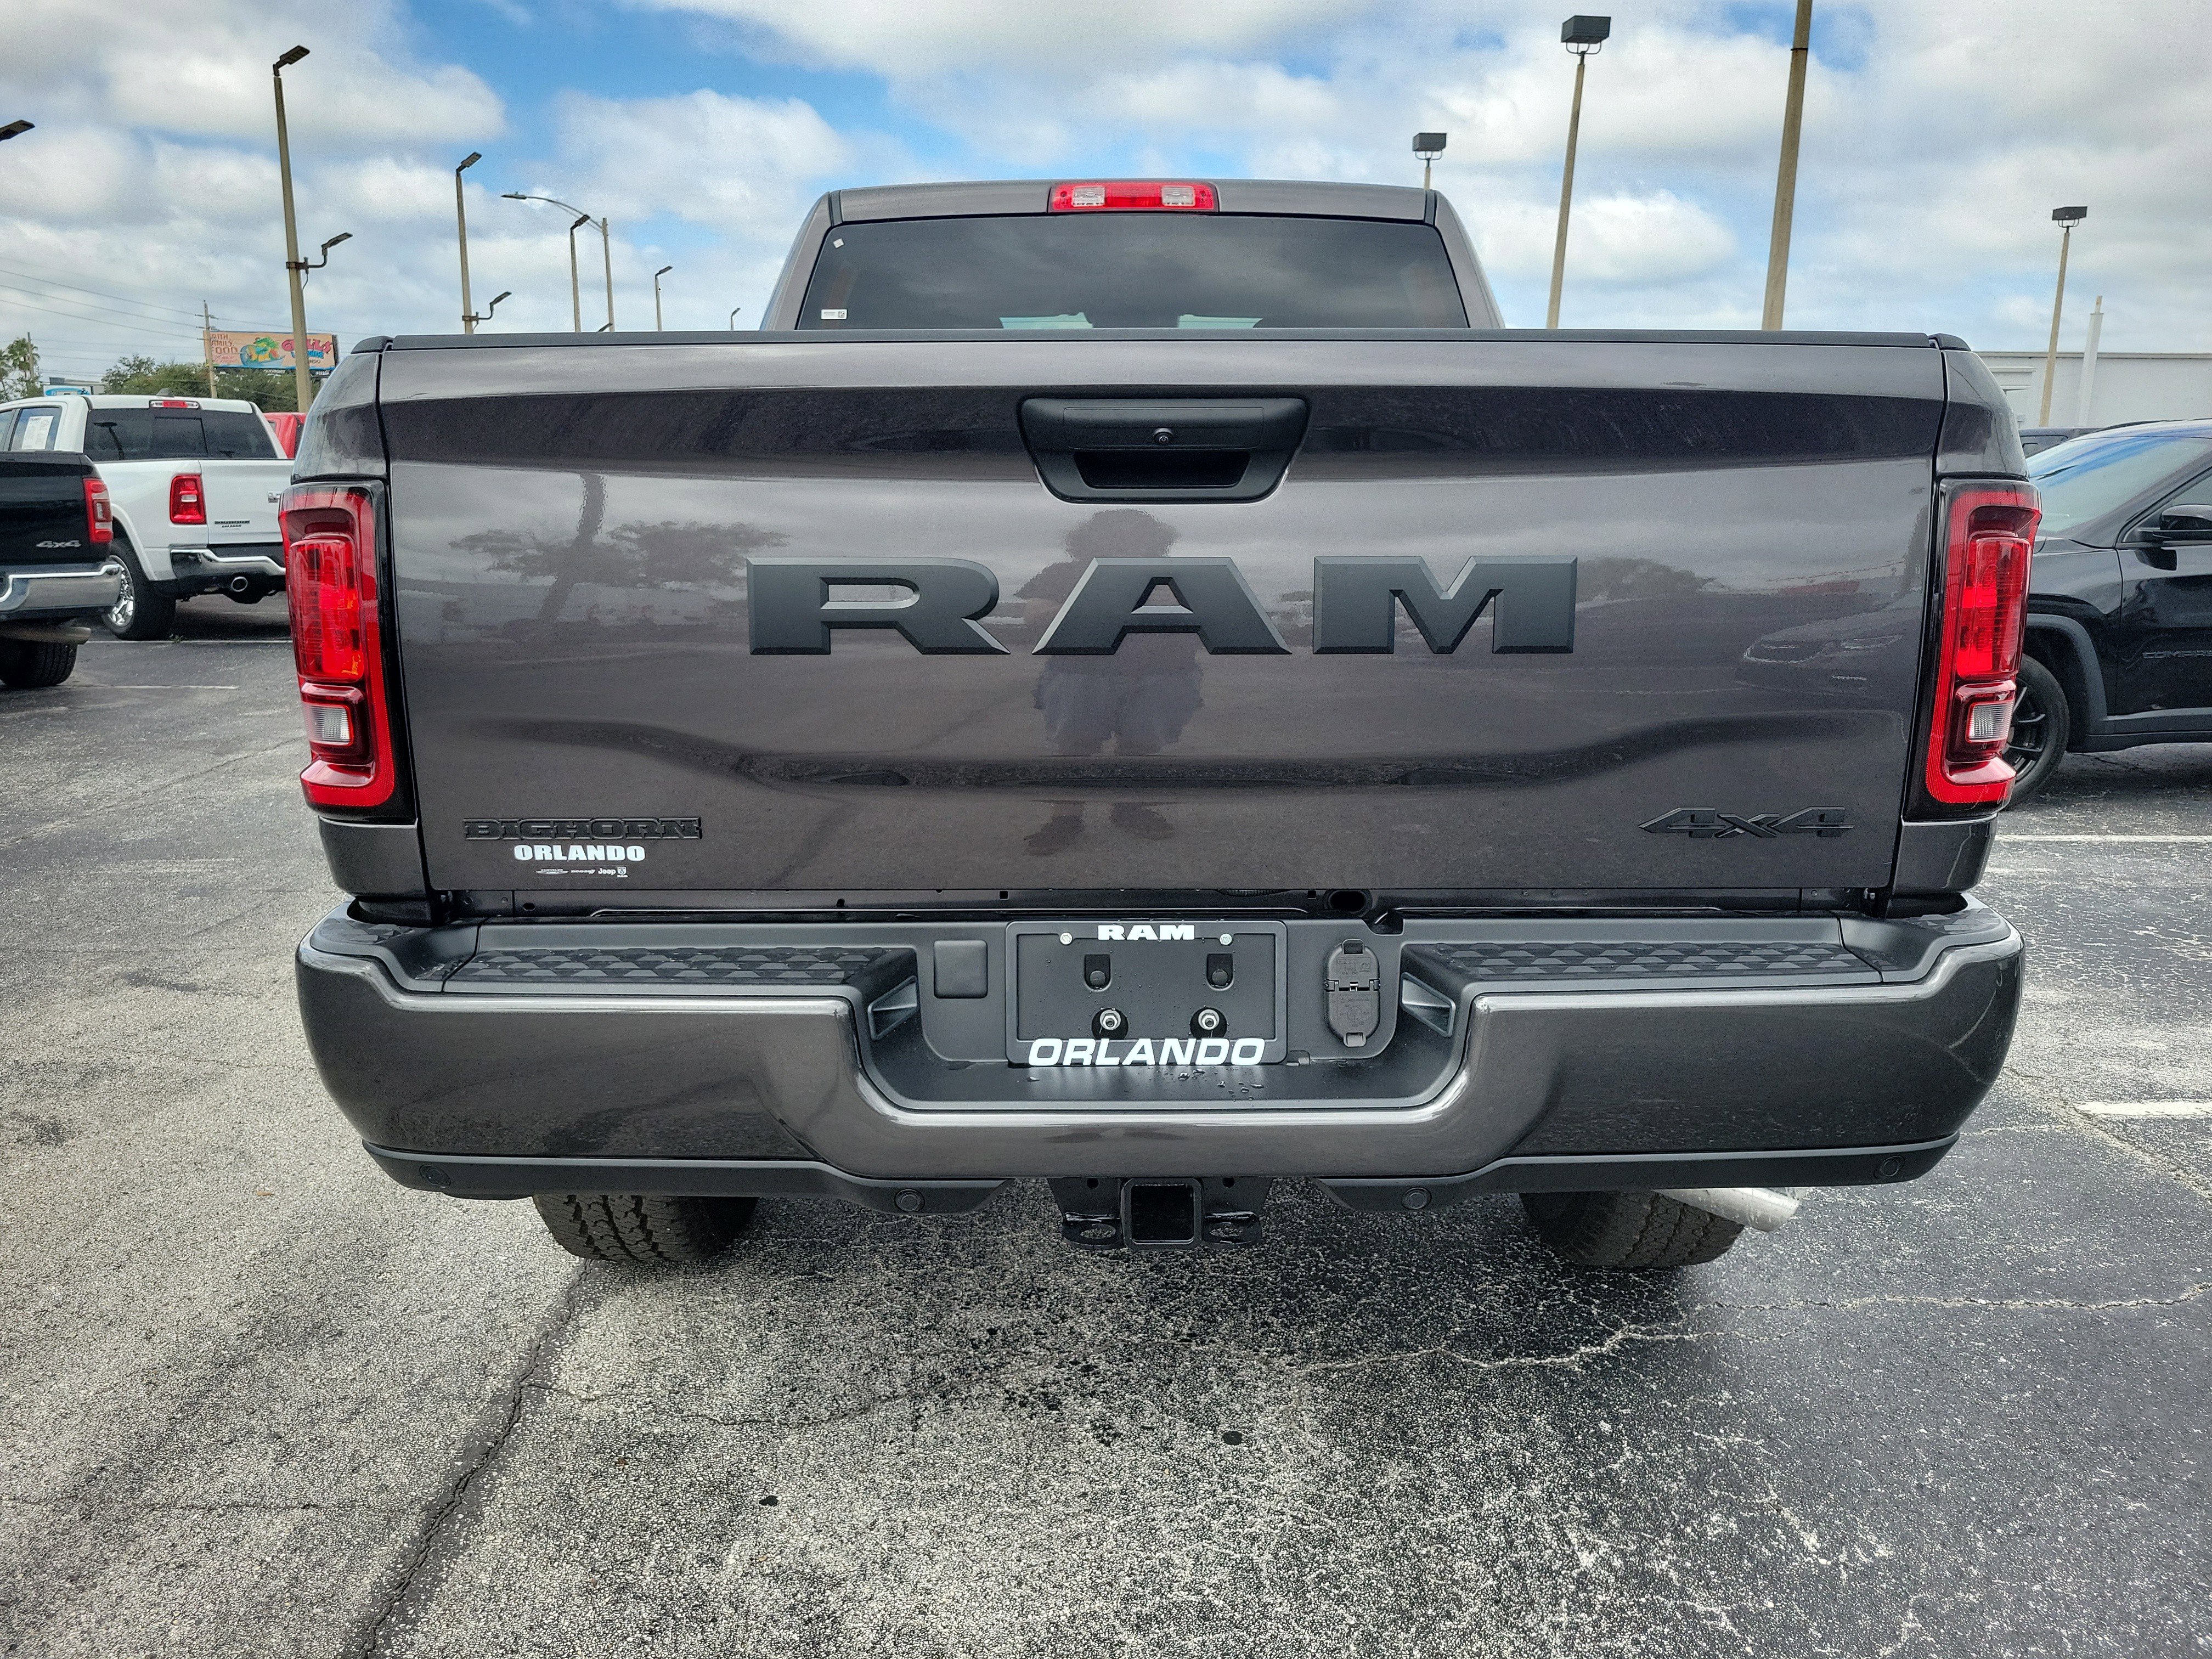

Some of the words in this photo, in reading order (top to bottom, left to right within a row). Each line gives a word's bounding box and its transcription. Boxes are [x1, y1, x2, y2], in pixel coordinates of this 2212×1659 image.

[747, 555, 1578, 656] RAM
[462, 816, 703, 841] BIGHORN
[514, 844, 646, 862] ORLANDO
[598, 867, 616, 876] Jeep
[1098, 924, 1195, 941] RAM
[1028, 1038, 1266, 1066] ORLANDO
